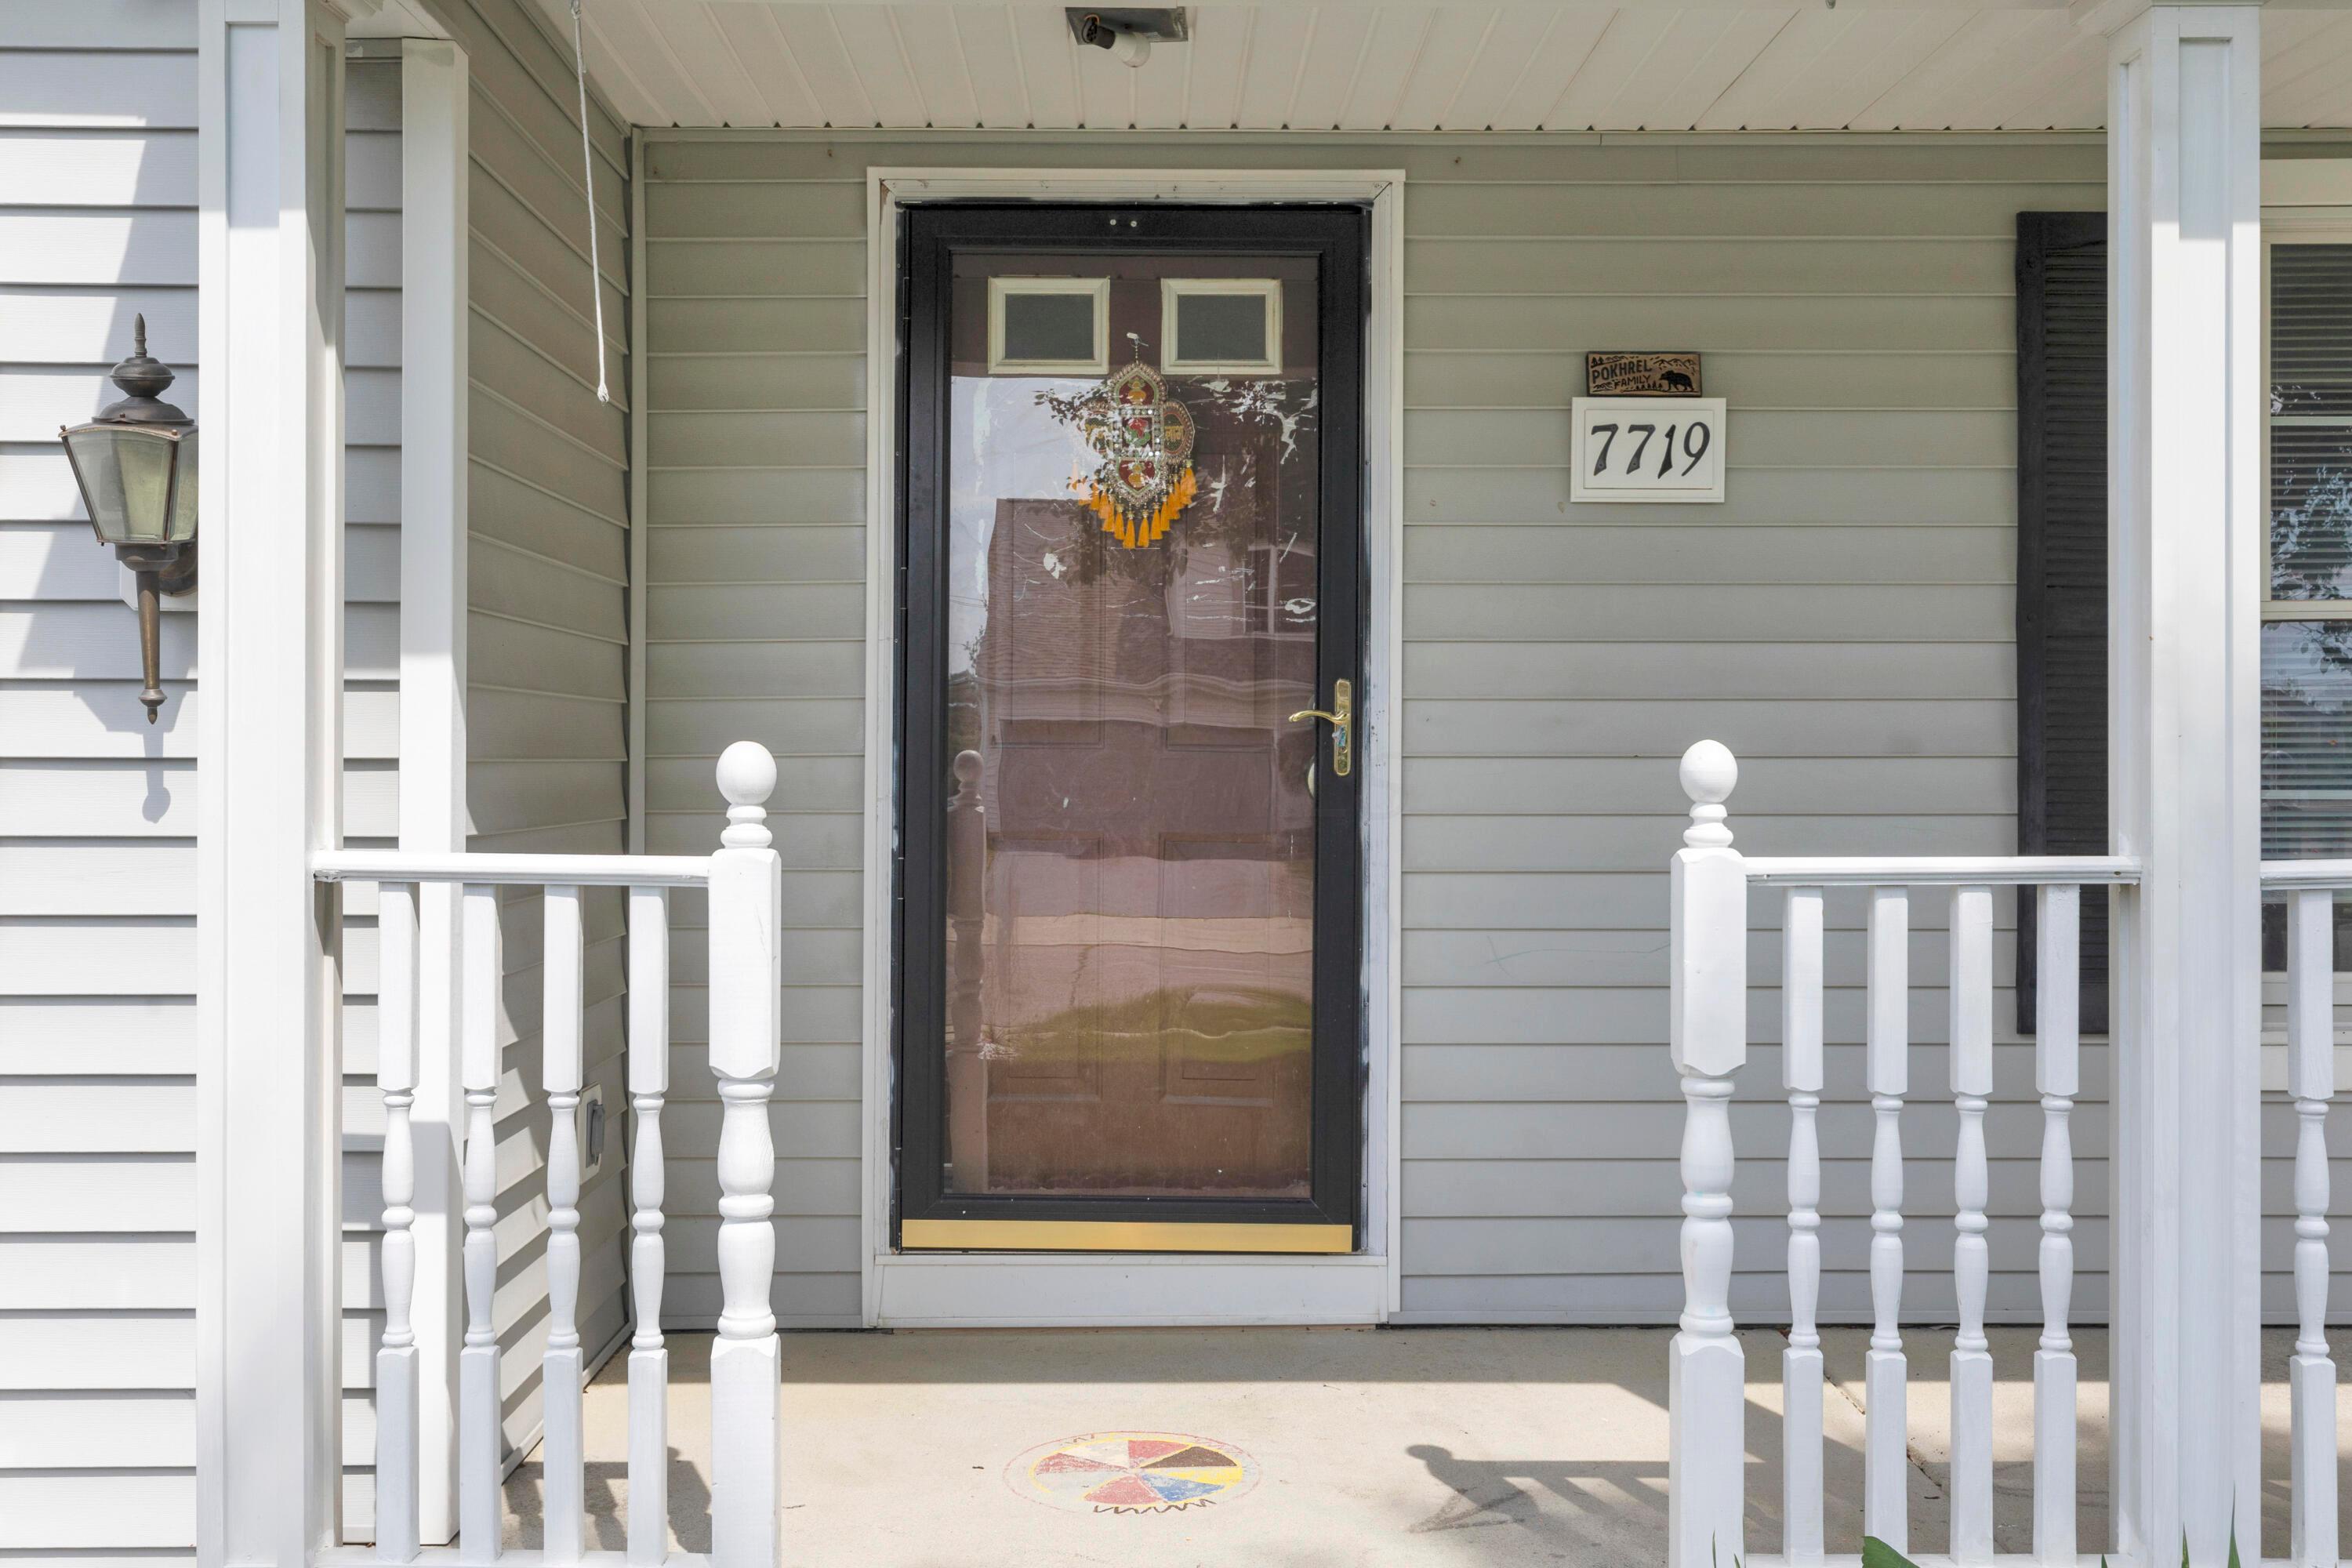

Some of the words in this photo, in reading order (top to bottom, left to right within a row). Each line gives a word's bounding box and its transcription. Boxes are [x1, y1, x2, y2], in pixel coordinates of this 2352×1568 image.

[1592, 359, 1653, 384] POKHREL
[1614, 375, 1651, 390] FAMILY
[1591, 421, 1711, 479] 7719
